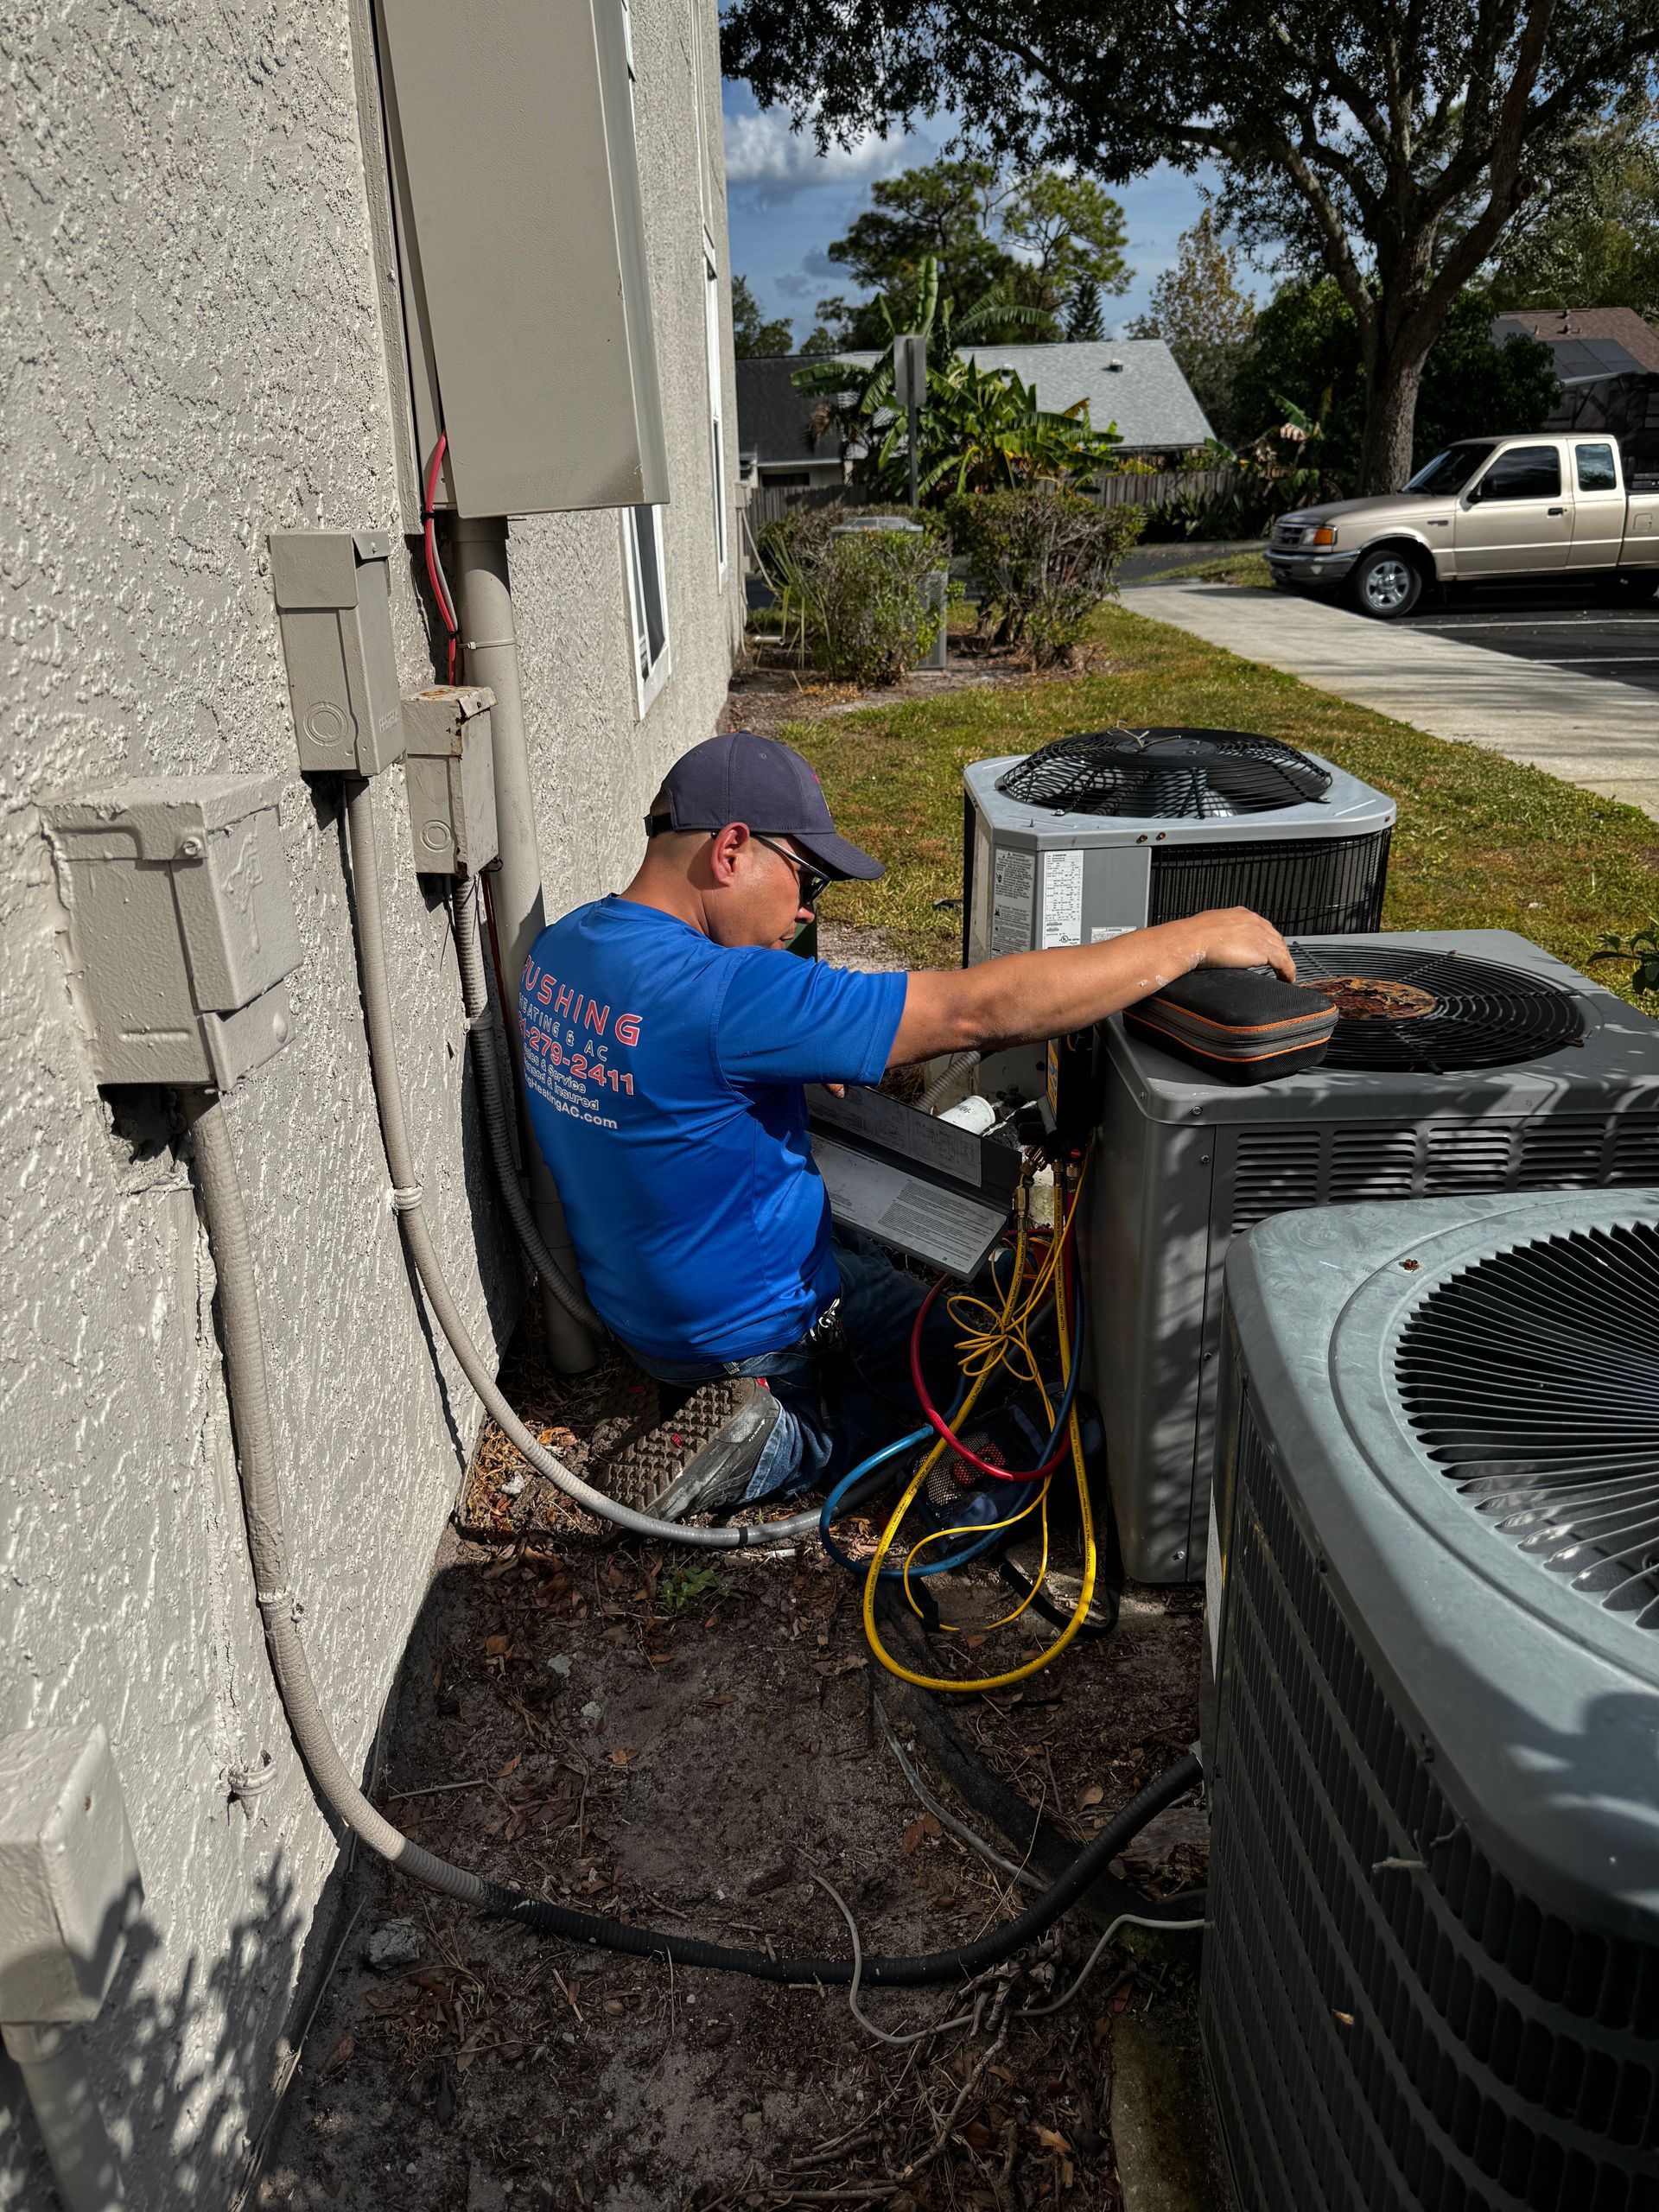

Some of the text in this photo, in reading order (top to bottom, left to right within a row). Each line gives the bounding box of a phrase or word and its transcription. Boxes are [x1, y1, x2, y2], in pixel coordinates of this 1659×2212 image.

[518, 991, 608, 1062] HEATING & AC
[540, 1058, 547, 1073] &
[547, 1064, 587, 1094] Service
[546, 1077, 553, 1090] &
